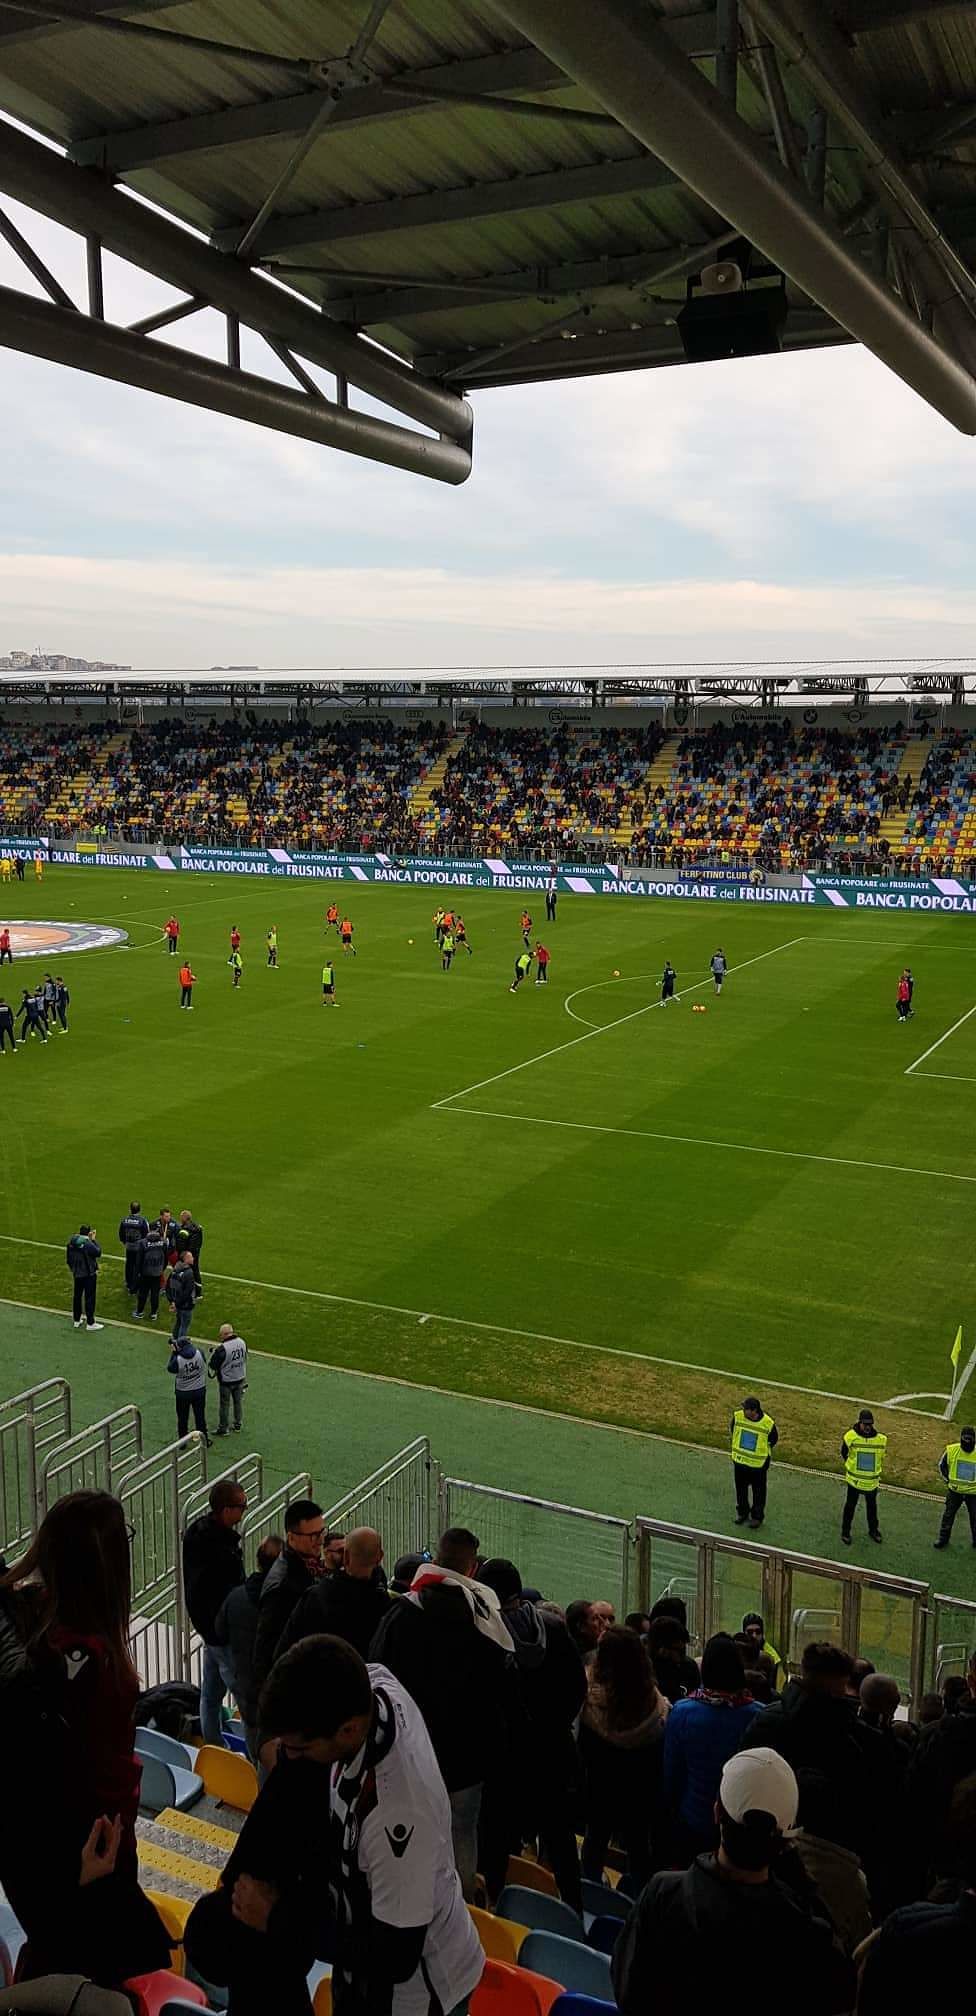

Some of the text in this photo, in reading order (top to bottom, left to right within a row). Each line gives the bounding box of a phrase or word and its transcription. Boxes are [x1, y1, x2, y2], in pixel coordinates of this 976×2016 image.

[1, 848, 32, 860] BANCA
[82, 855, 94, 864] del
[95, 855, 147, 866] FRUSINATE
[240, 850, 268, 858] FRUSINATE
[311, 854, 338, 862] POPOLARE
[181, 858, 344, 878] BANCA POPOLARE del FRUSINATE
[414, 859, 443, 867] POPOLARE
[452, 861, 483, 869] FRUSINATE
[572, 867, 606, 875] FRUSINATE
[726, 871, 748, 880] CLUB
[374, 868, 558, 889] BANCA POPOLARE del FRUSINATE
[816, 878, 840, 886] BANCA
[840, 879, 878, 887] POPOLARE
[889, 881, 930, 889] FRUSINATE
[602, 880, 816, 902] BANCA POPOLARE del FRUSINATE
[856, 892, 906, 907] BANCA
[231, 1347, 244, 1360] 231
